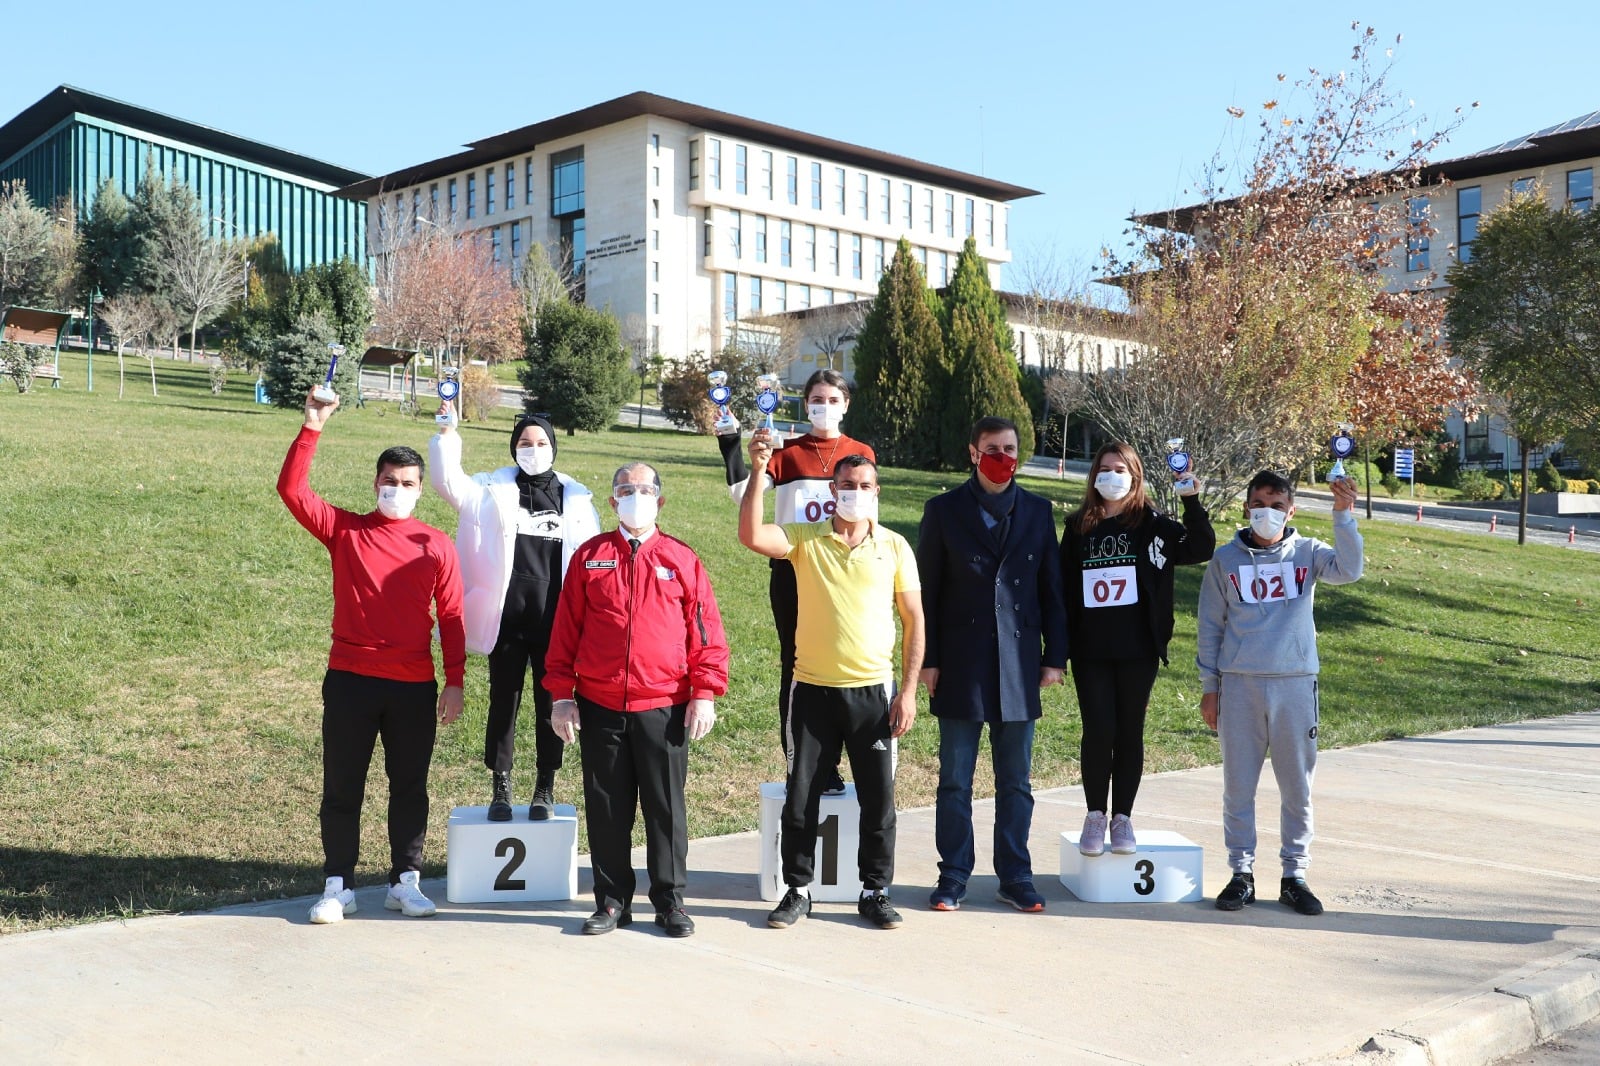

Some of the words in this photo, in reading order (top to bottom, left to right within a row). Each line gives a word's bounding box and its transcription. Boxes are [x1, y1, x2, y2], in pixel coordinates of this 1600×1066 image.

[804, 500, 838, 523] 09
[1089, 533, 1128, 559] LOS
[1092, 578, 1127, 603] 07
[1250, 575, 1285, 601] 02
[816, 814, 839, 886] 1
[493, 837, 527, 891] 2
[1133, 859, 1156, 896] 3
